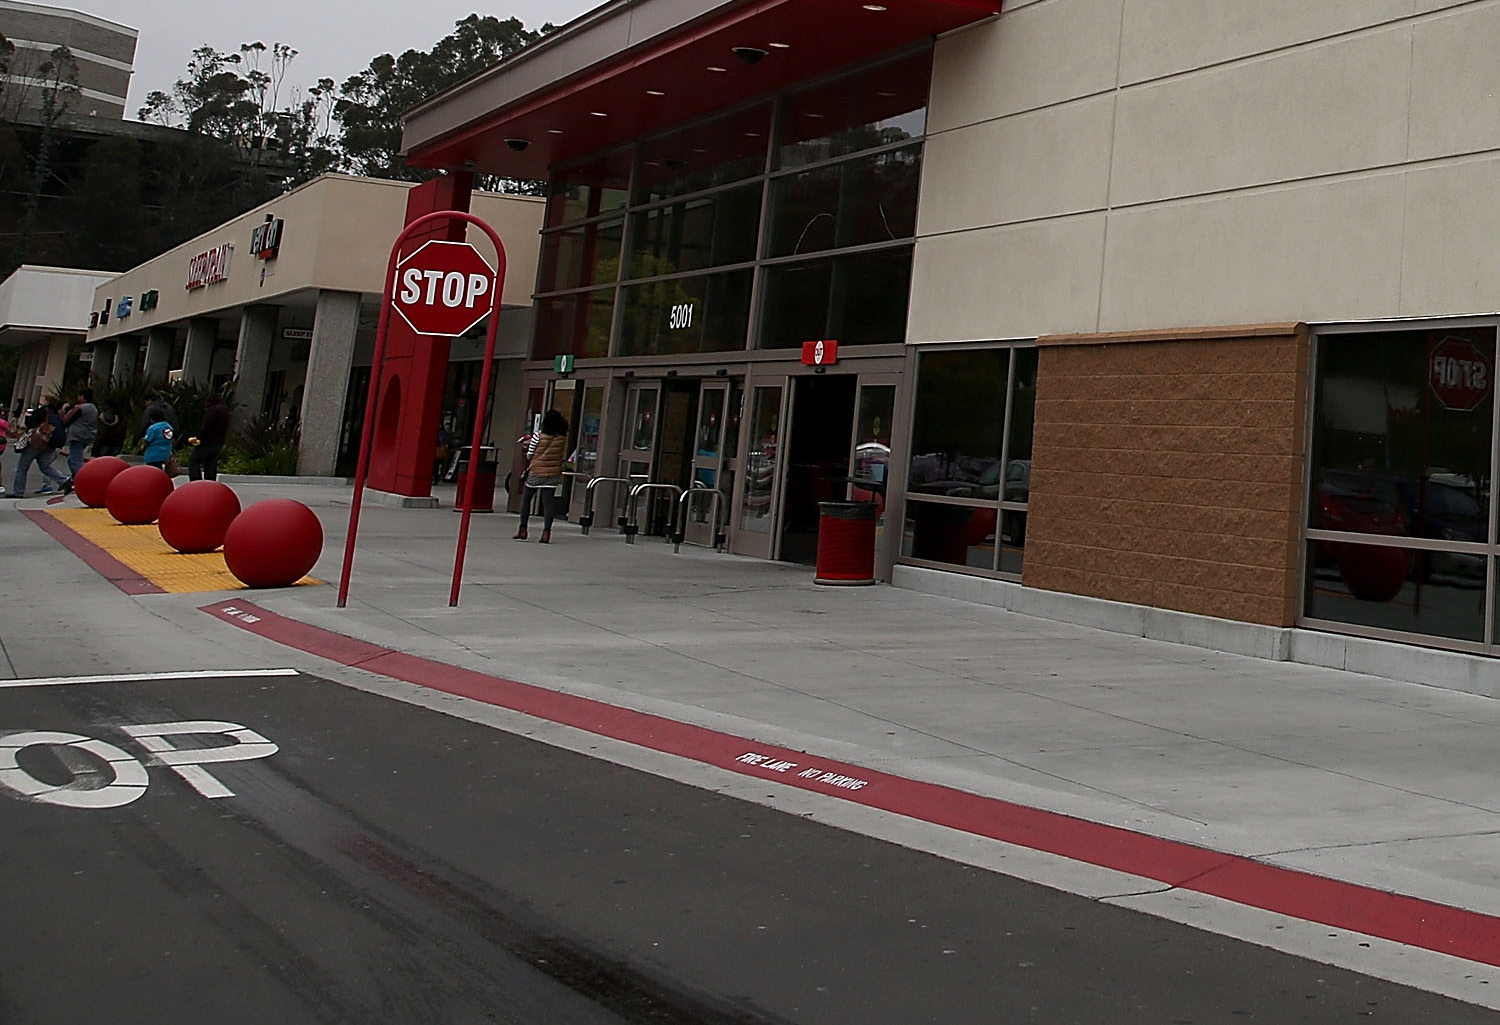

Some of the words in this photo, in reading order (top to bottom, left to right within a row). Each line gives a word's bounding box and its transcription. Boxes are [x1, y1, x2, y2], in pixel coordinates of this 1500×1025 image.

[400, 268, 489, 309] STOP
[669, 303, 694, 329] 5001
[735, 752, 768, 765] FIRE
[760, 758, 798, 773] LANE
[798, 767, 822, 779] NO
[818, 772, 869, 790] PARKING
